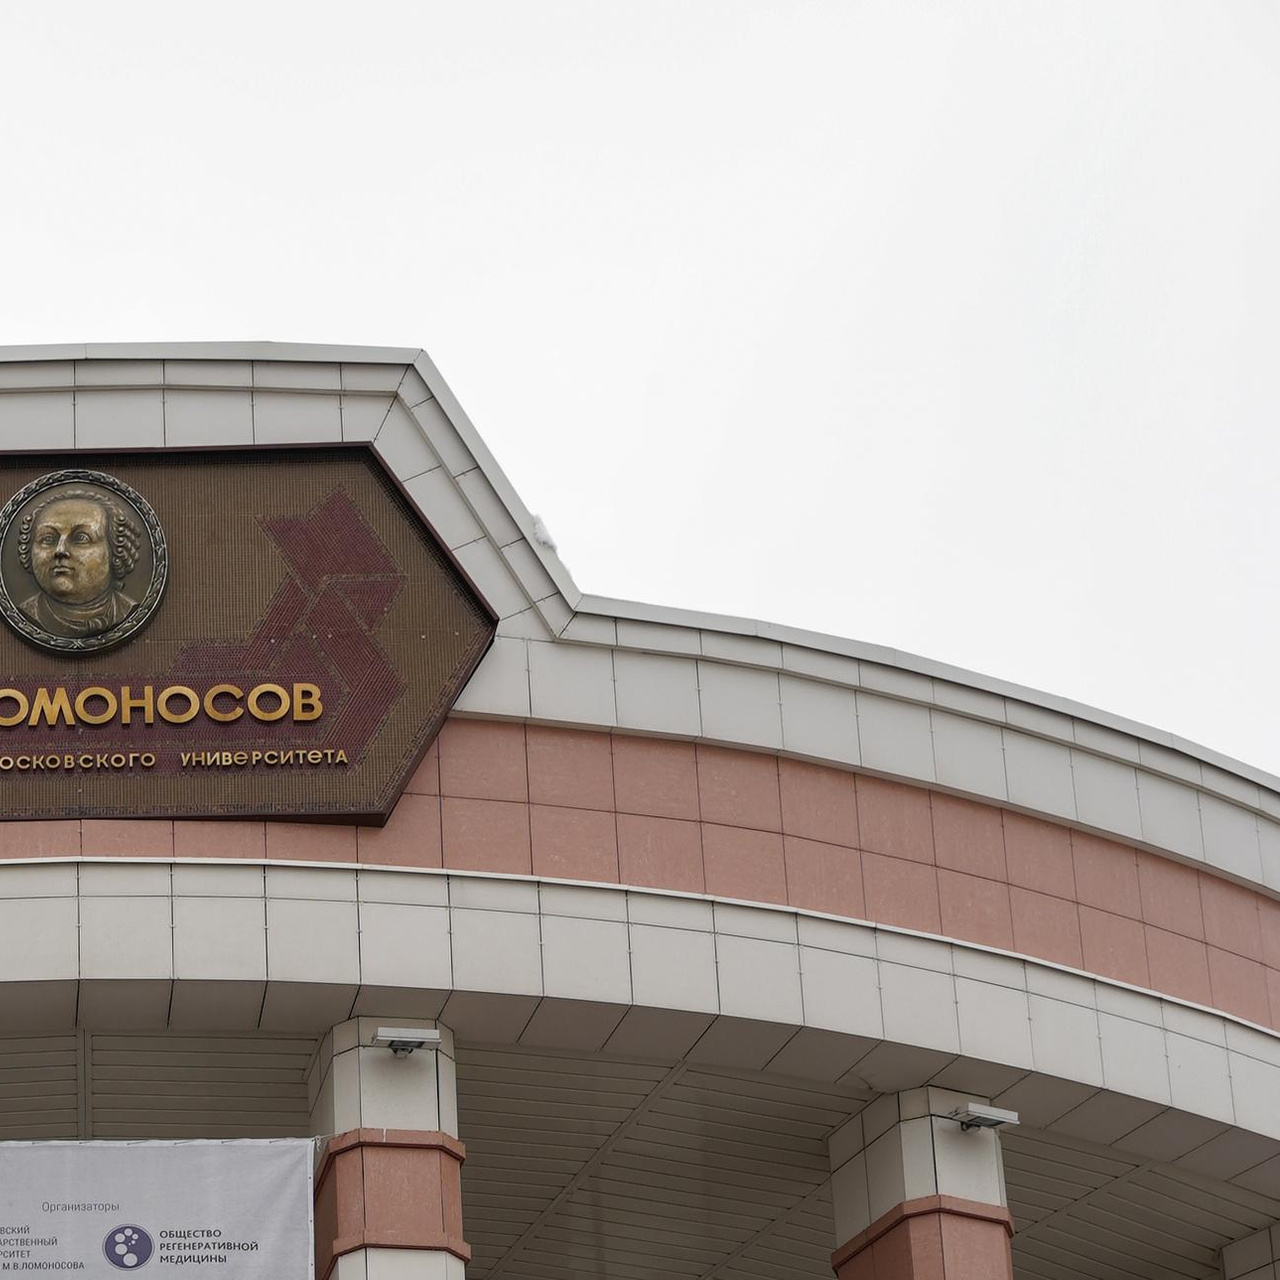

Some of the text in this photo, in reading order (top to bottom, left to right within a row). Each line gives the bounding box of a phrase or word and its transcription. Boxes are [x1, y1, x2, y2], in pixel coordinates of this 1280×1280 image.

[42, 1202, 119, 1213] Организаторы
[159, 1228, 222, 1240] ОБЩЕСТВО
[159, 1240, 259, 1253] РЕГЕНЕРАТИВНОЙ
[160, 1255, 226, 1264] МЕДИЦИНЫ
